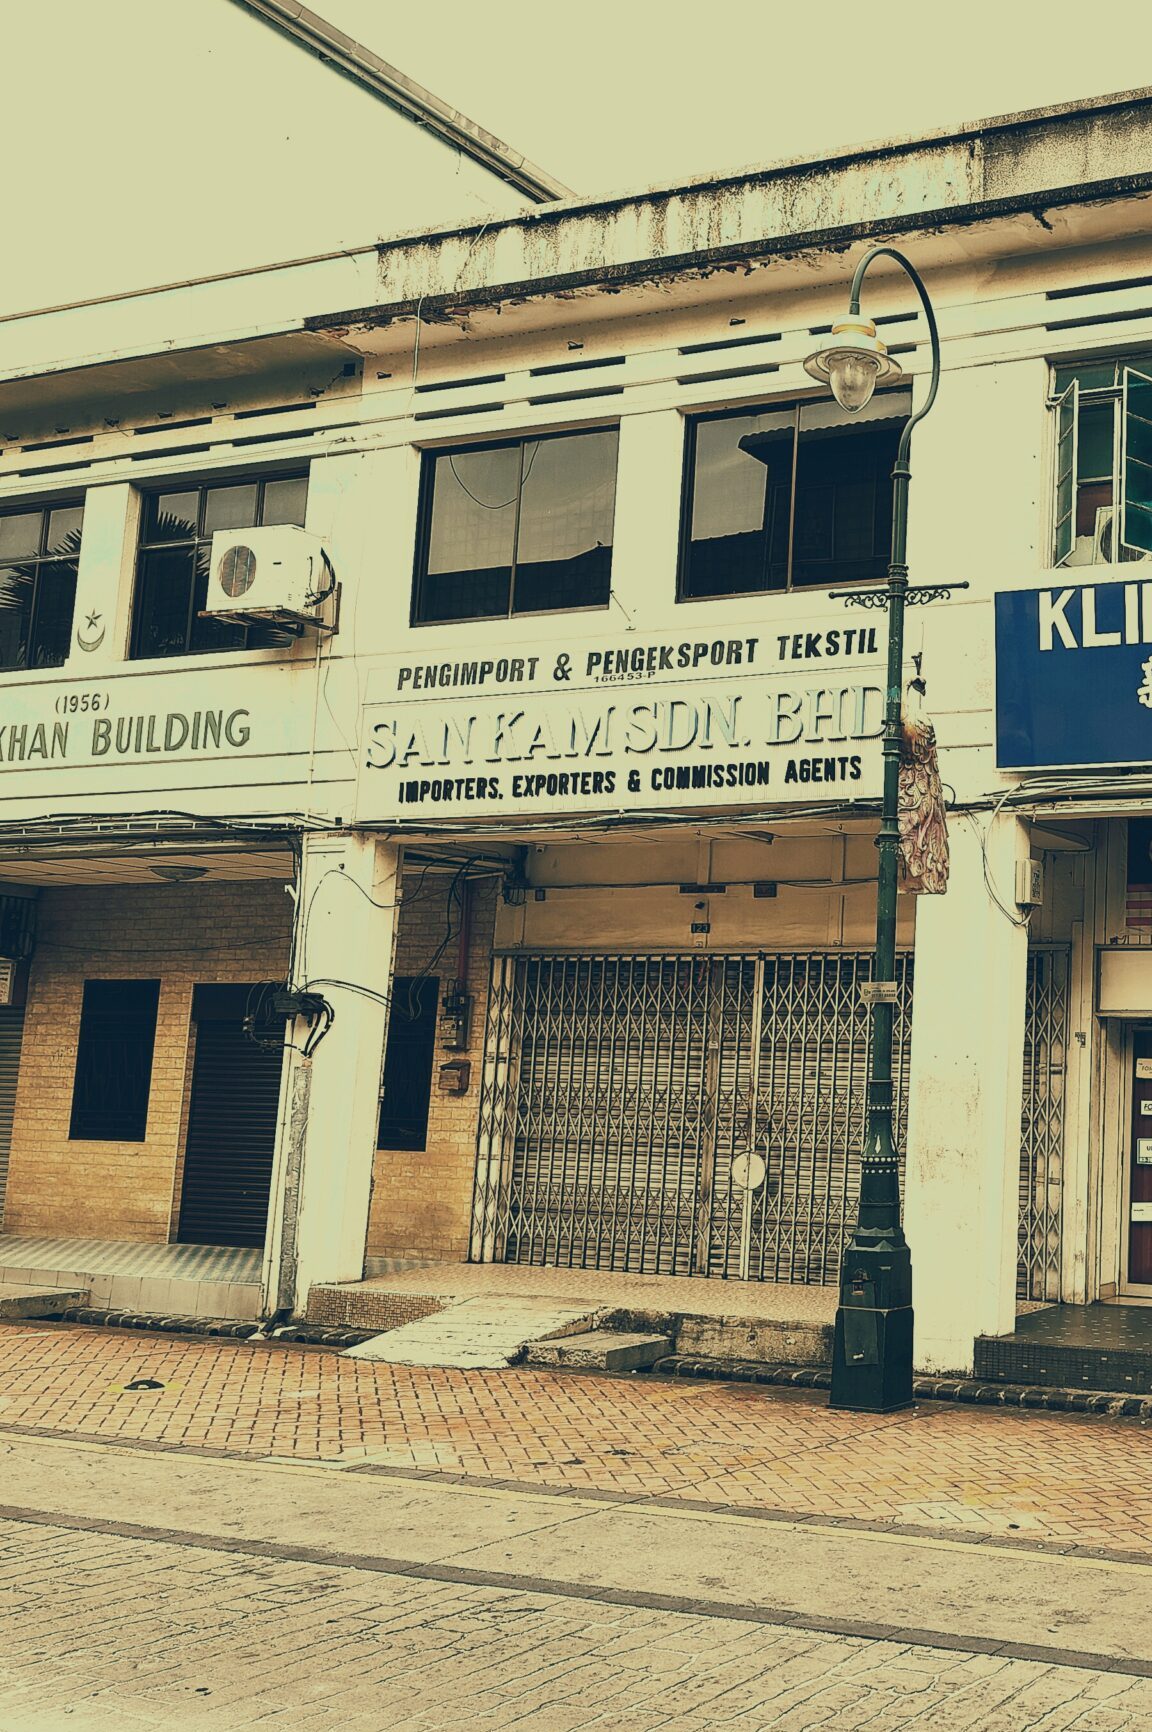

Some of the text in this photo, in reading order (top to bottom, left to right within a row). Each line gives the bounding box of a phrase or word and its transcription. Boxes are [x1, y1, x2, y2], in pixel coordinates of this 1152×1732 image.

[397, 628, 878, 691] PENGIMPORT & PENGEKSPORT TEKSTIL
[593, 671, 656, 683] 166453-P
[55, 693, 110, 714] (1956)
[91, 708, 251, 757] BUILDING
[366, 713, 477, 769] SAN
[485, 704, 617, 763] KAM
[624, 694, 751, 754] SDN.
[512, 770, 616, 798] EXPORTERS
[627, 769, 641, 793] &
[651, 761, 769, 792] COMMISSION
[784, 755, 862, 784] AGENTS
